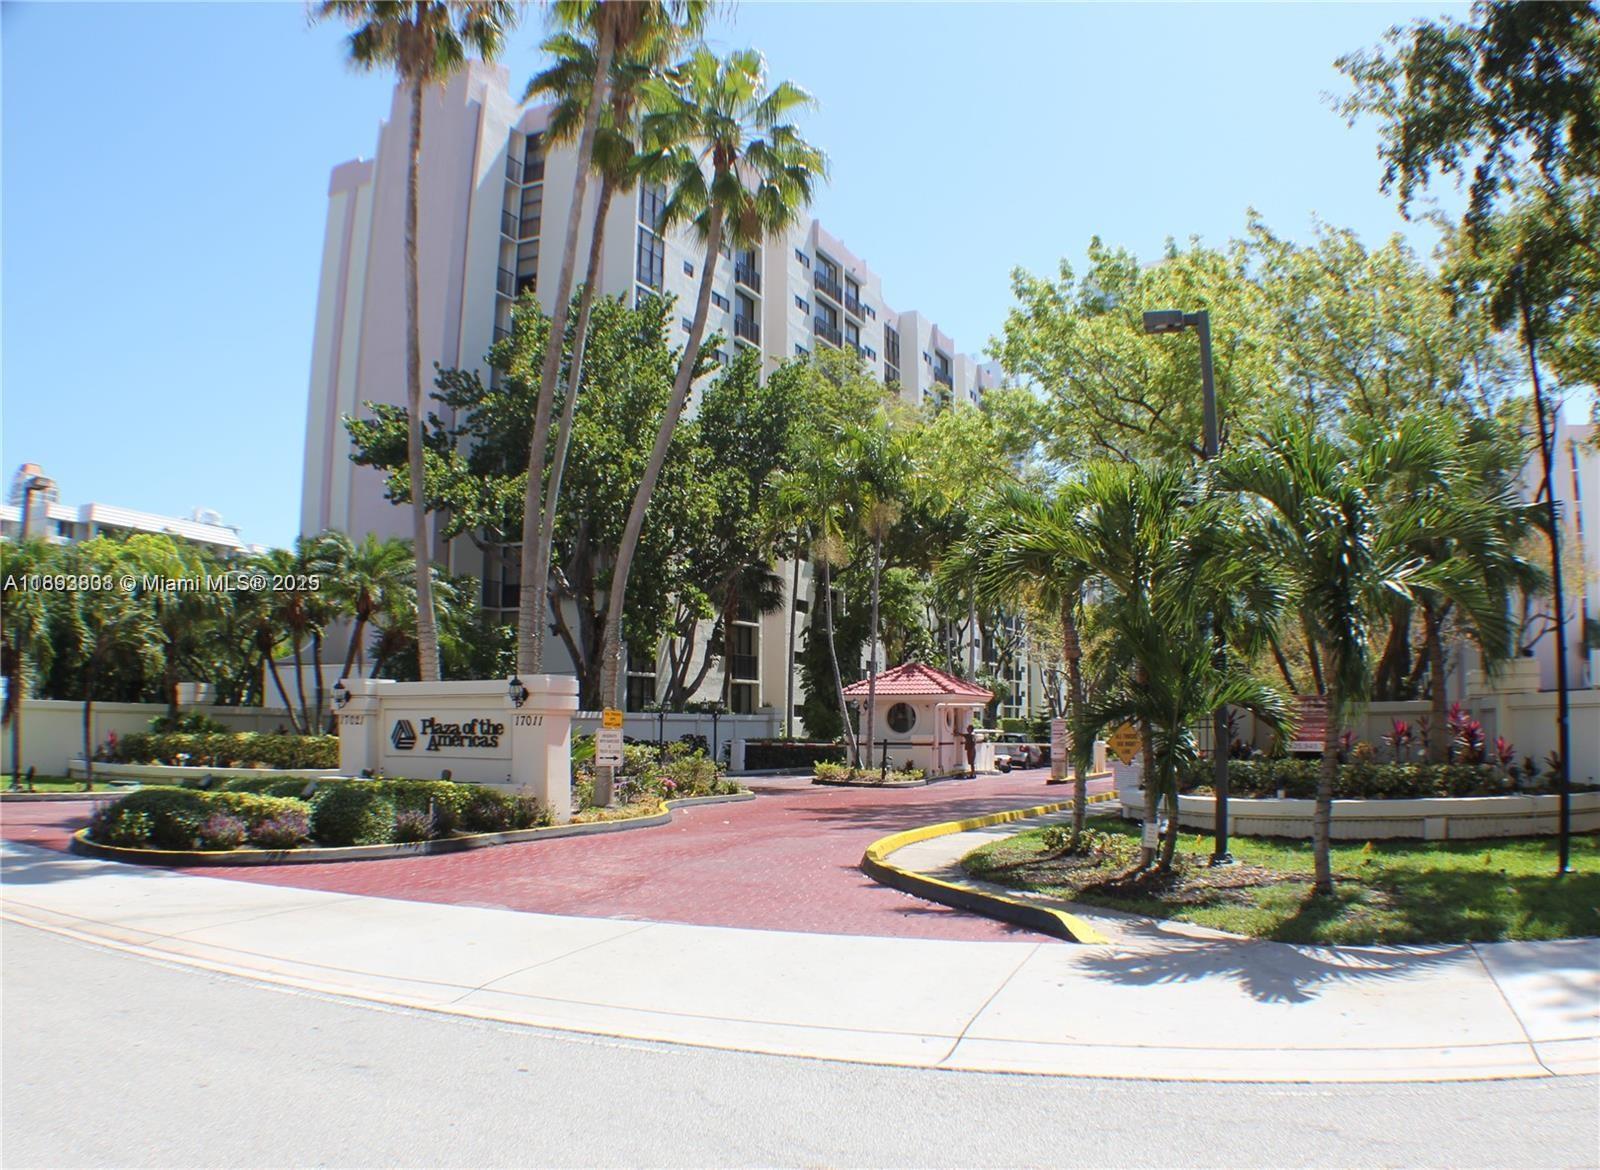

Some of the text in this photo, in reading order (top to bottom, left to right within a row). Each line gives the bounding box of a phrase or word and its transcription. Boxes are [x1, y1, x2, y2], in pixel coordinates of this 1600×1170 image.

[420, 717, 505, 736] Plaza of the
[515, 715, 543, 727] 17011
[425, 735, 499, 751] Americas
